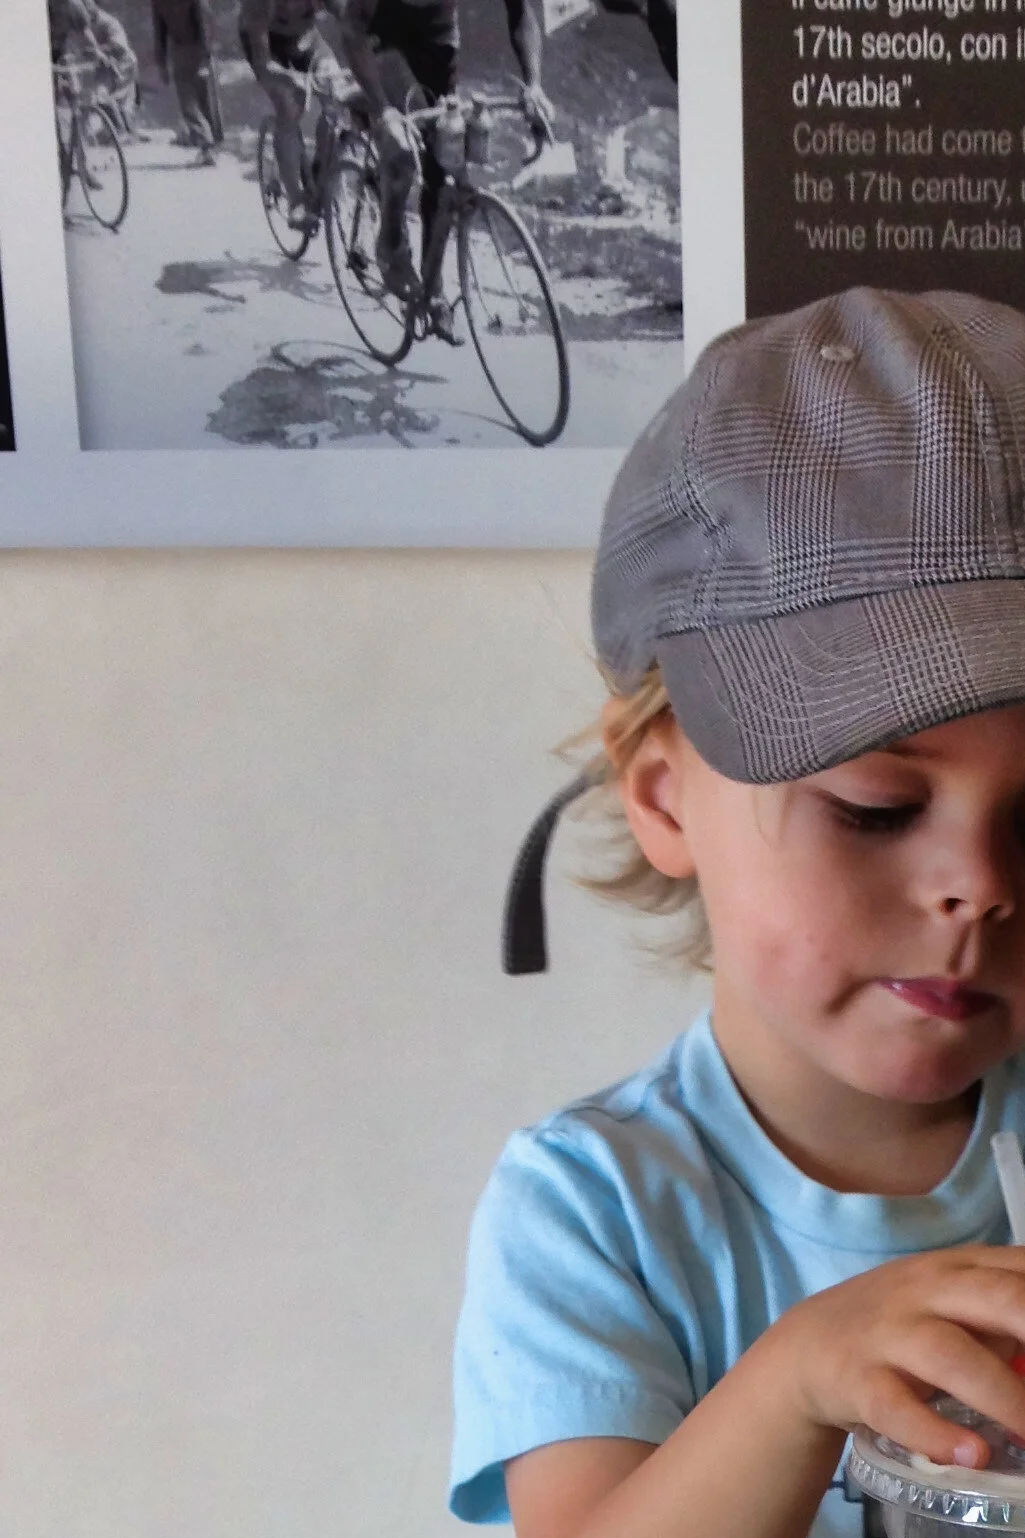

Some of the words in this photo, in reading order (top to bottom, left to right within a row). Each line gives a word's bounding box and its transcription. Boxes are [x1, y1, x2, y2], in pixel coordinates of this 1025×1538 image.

[793, 24, 853, 59] 17th
[861, 25, 952, 64] secolo,
[960, 32, 1008, 61] con
[792, 121, 876, 156] Coffee
[884, 123, 934, 156] had
[941, 129, 1013, 156] come
[793, 171, 835, 203] the
[845, 171, 902, 203] 17th
[911, 173, 1012, 209] century,
[875, 218, 935, 251] from
